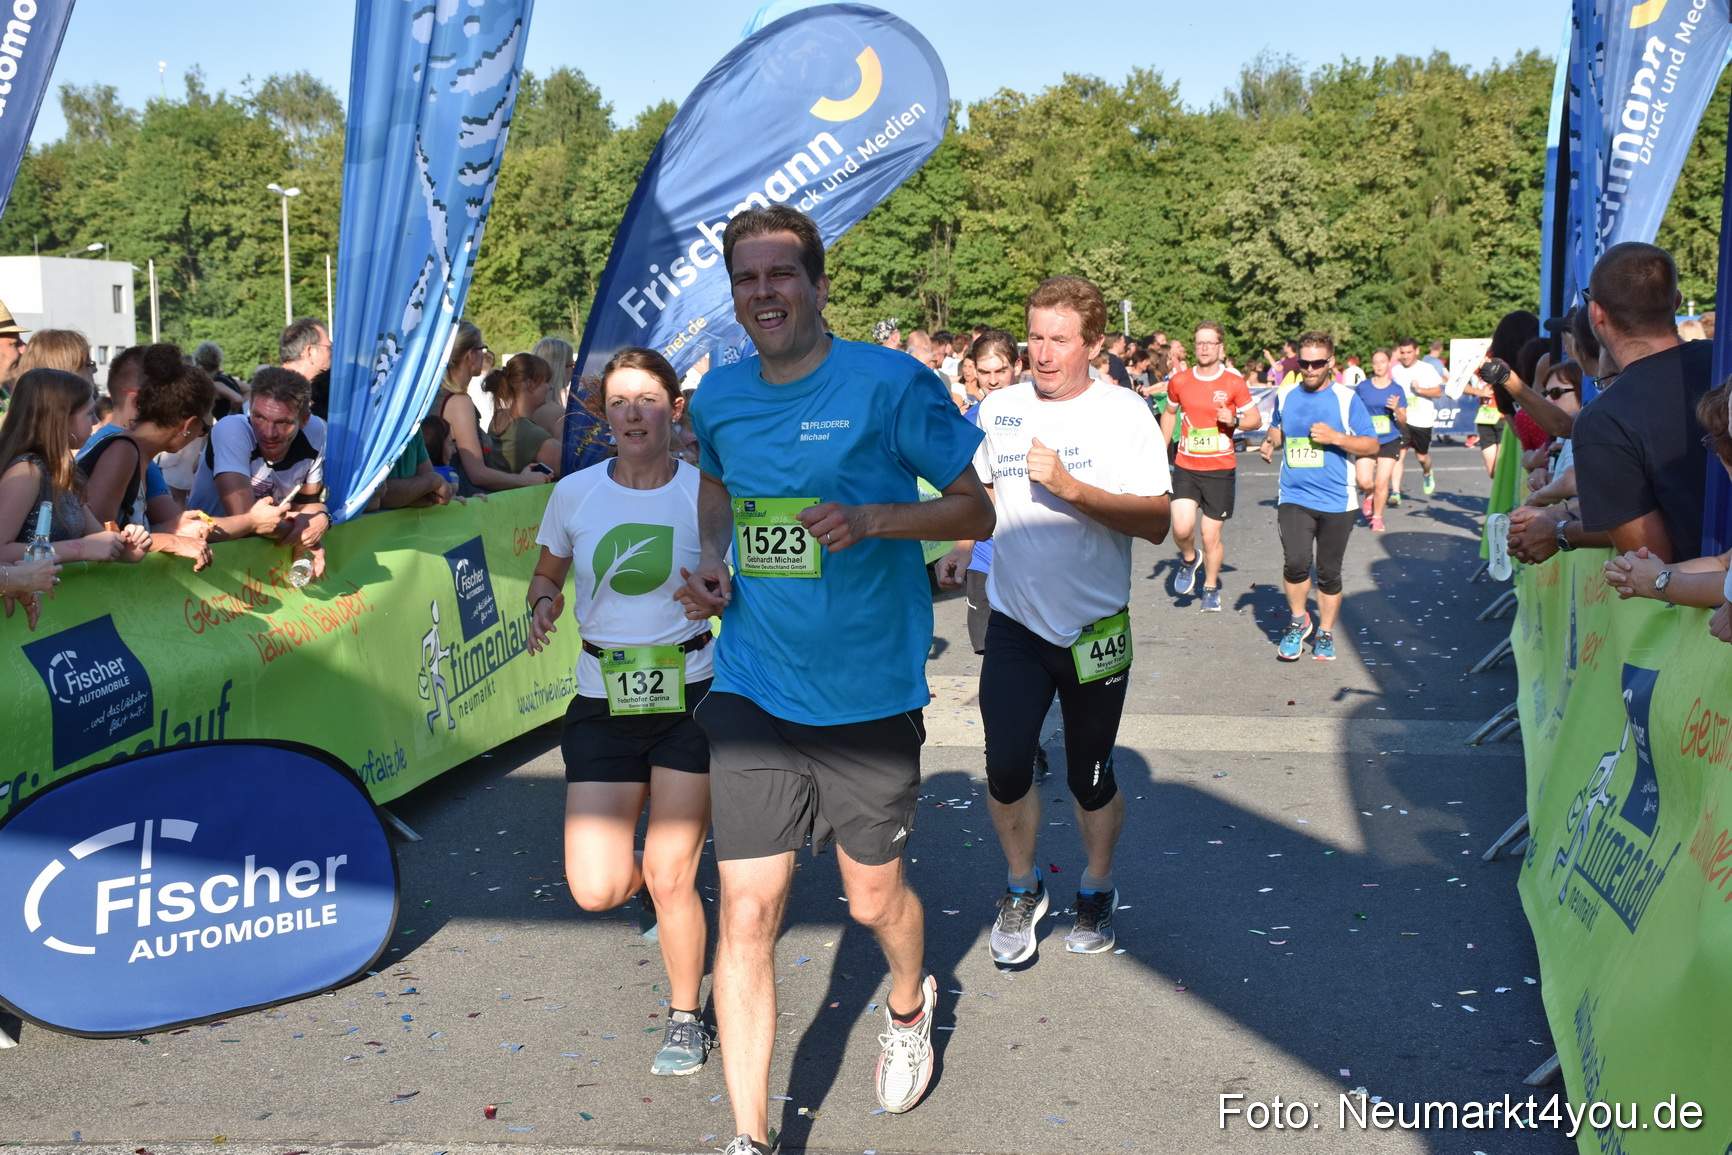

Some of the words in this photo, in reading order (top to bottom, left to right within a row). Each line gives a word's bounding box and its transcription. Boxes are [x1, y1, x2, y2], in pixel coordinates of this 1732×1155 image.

[1639, 98, 1669, 165] Druck
[1660, 48, 1686, 94] und
[822, 155, 860, 193] und
[856, 101, 926, 162] Medien
[809, 419, 850, 430] PFLEIDERER
[994, 415, 1023, 427] DESS
[800, 432, 830, 442] Michael
[1193, 437, 1211, 446] 541
[997, 453, 1026, 464] Unser
[1064, 446, 1080, 456] ist
[1289, 449, 1318, 459] 1175
[742, 526, 807, 555] 1523
[746, 555, 773, 564] Gebhardt
[774, 556, 803, 564] Michael
[461, 568, 485, 593] Fischer
[247, 615, 319, 666] laufen
[1089, 633, 1127, 662] 449
[64, 656, 126, 696] Fischer
[1096, 659, 1114, 668] Meyer
[78, 675, 131, 707] AUTOMOBILE
[617, 669, 664, 696] 132
[458, 679, 496, 719] neumarkt
[617, 695, 648, 704] Federhofer
[95, 854, 348, 936] Fischer
[127, 903, 339, 964] AUTOMOBILE
